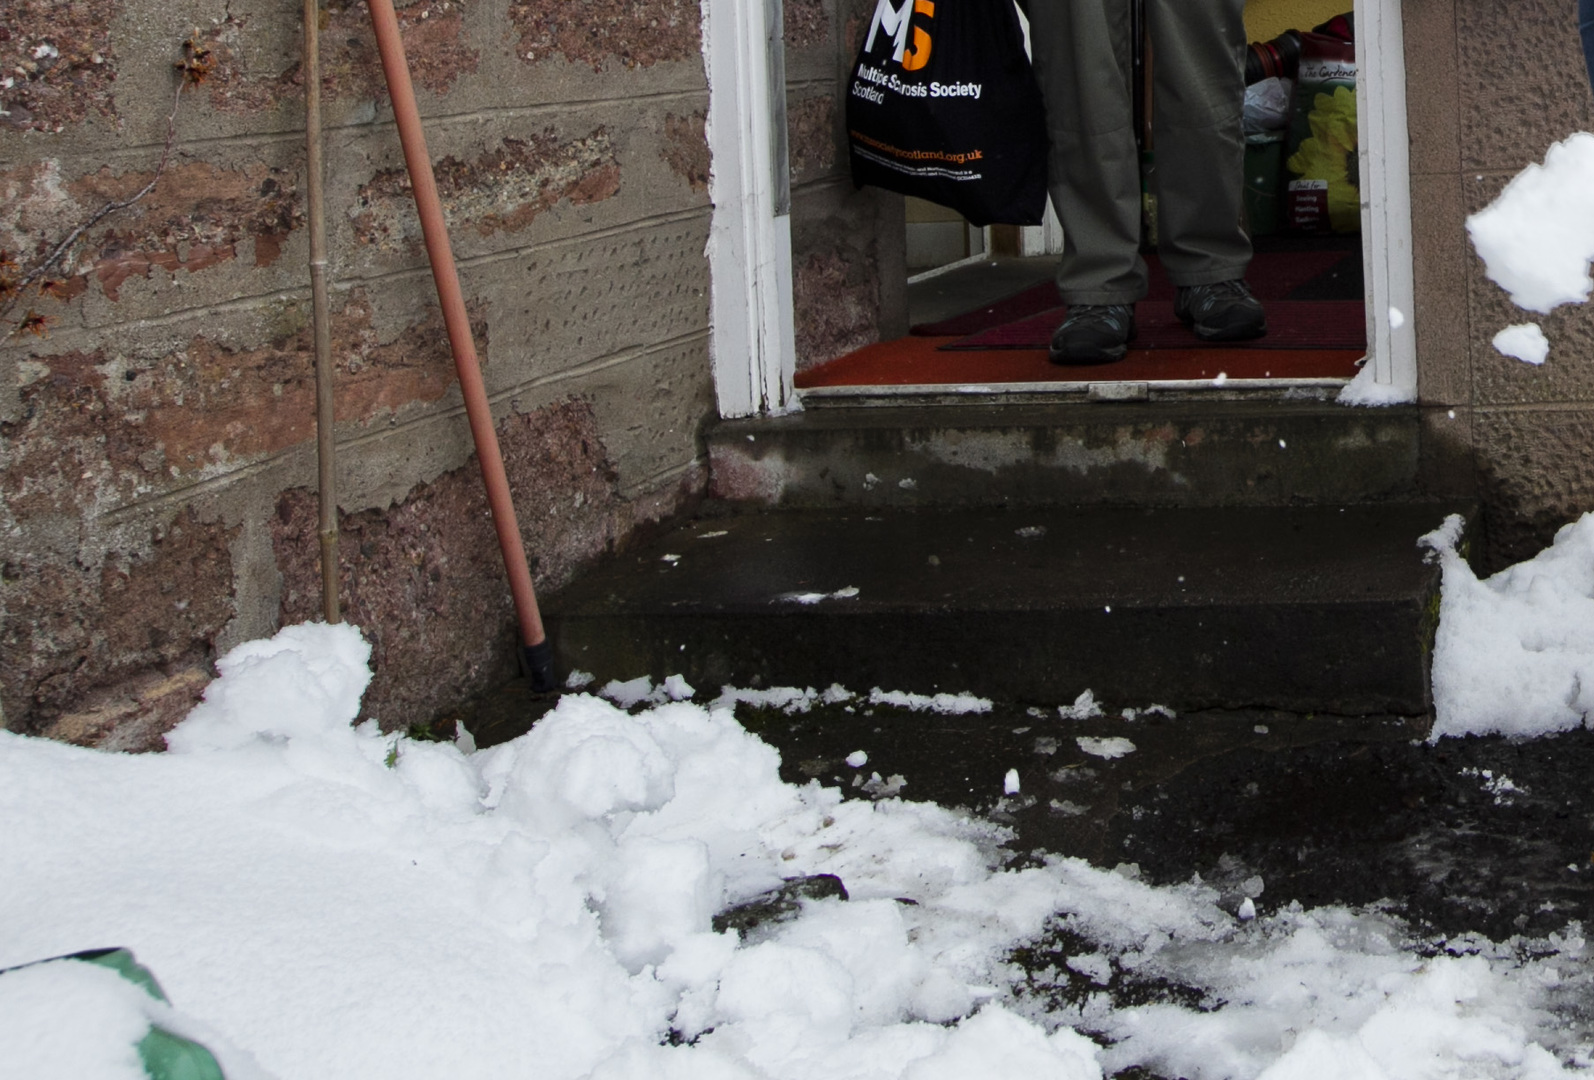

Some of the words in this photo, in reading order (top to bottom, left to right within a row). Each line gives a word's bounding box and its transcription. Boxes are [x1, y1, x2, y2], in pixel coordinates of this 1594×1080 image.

[857, 63, 889, 87] Multipe
[888, 74, 927, 97] Scrosis
[930, 81, 982, 99] Society
